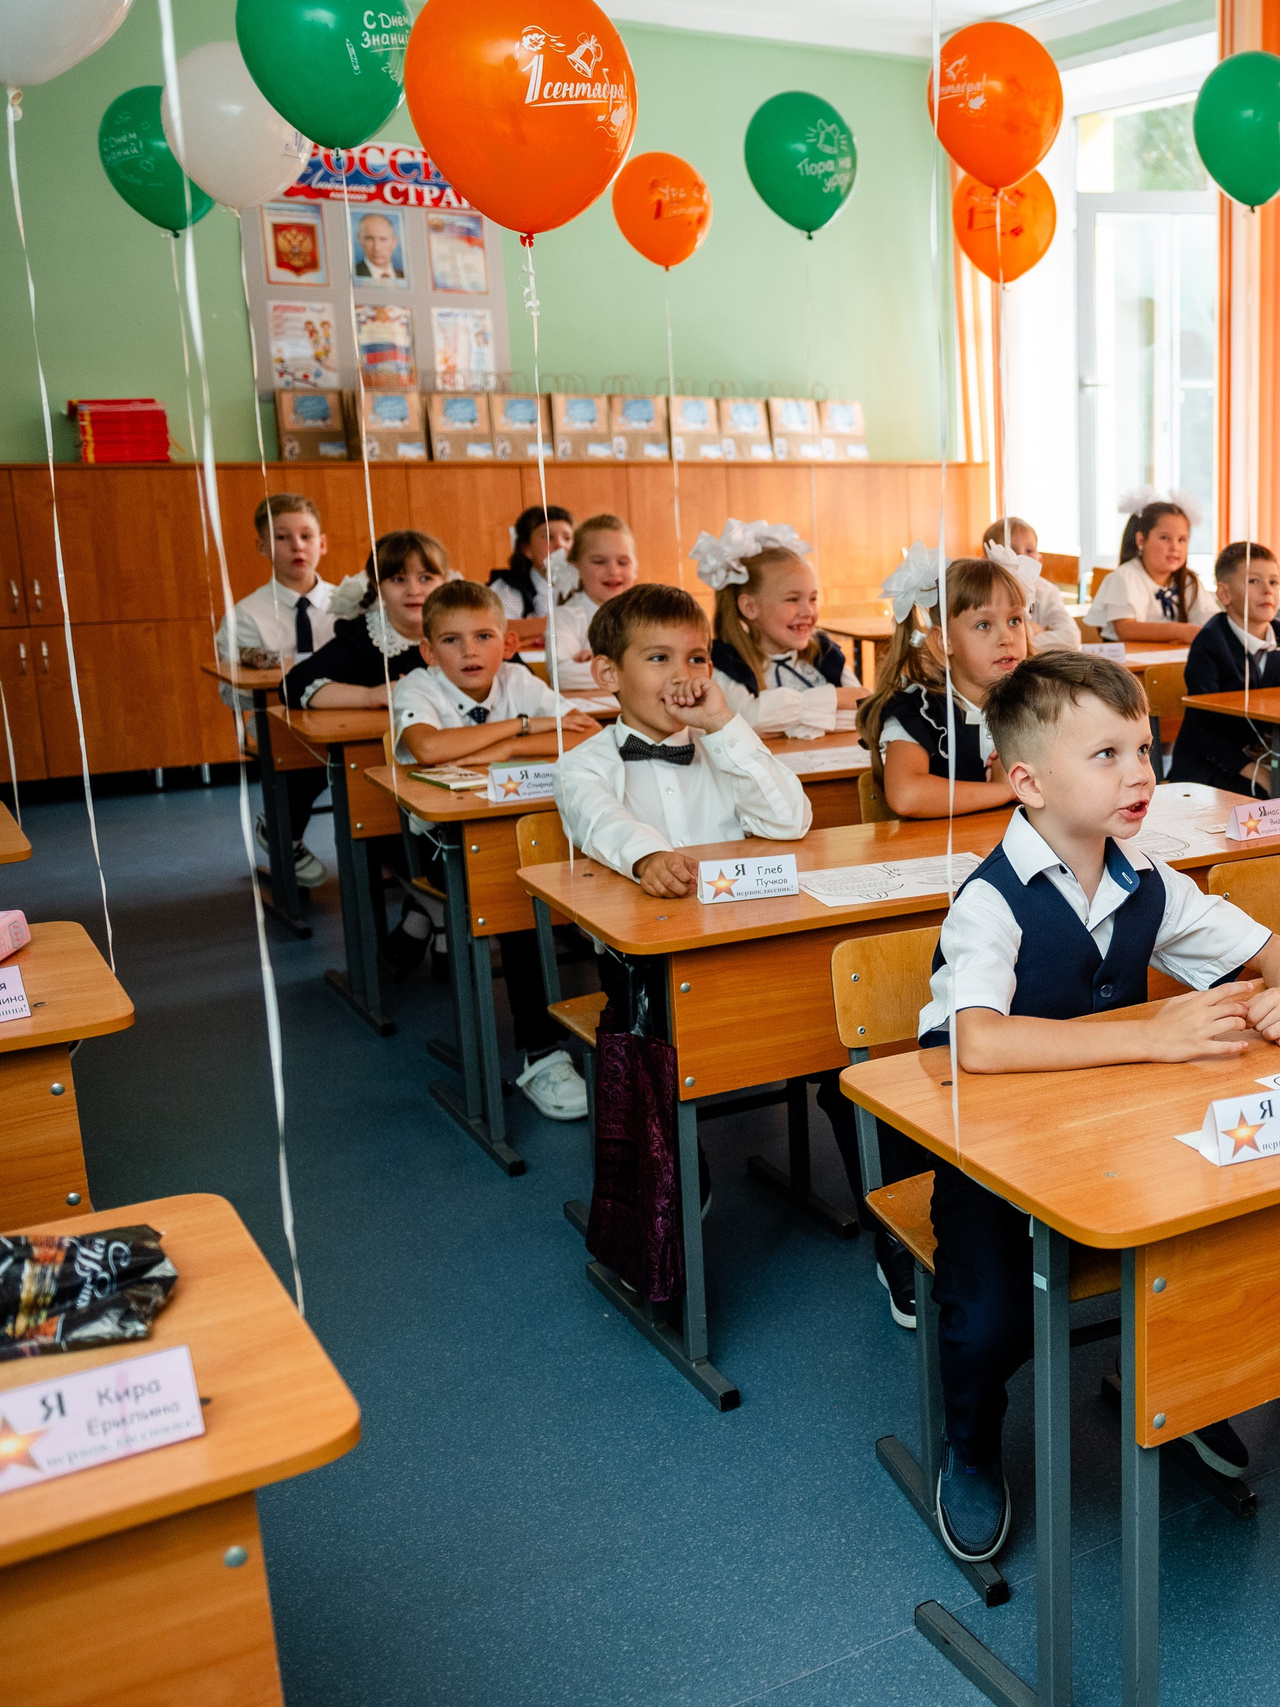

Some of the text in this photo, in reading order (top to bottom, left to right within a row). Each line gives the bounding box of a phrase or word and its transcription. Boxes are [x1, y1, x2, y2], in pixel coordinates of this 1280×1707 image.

[362, 10, 376, 29] С
[521, 54, 628, 113] 1 сентября!
[796, 157, 836, 179] Пора
[519, 769, 530, 781] Я
[734, 863, 783, 877] Я Глеб
[755, 878, 789, 888] Пучков
[1259, 1099, 1275, 1120] Я
[39, 1378, 162, 1423] Я Кира
